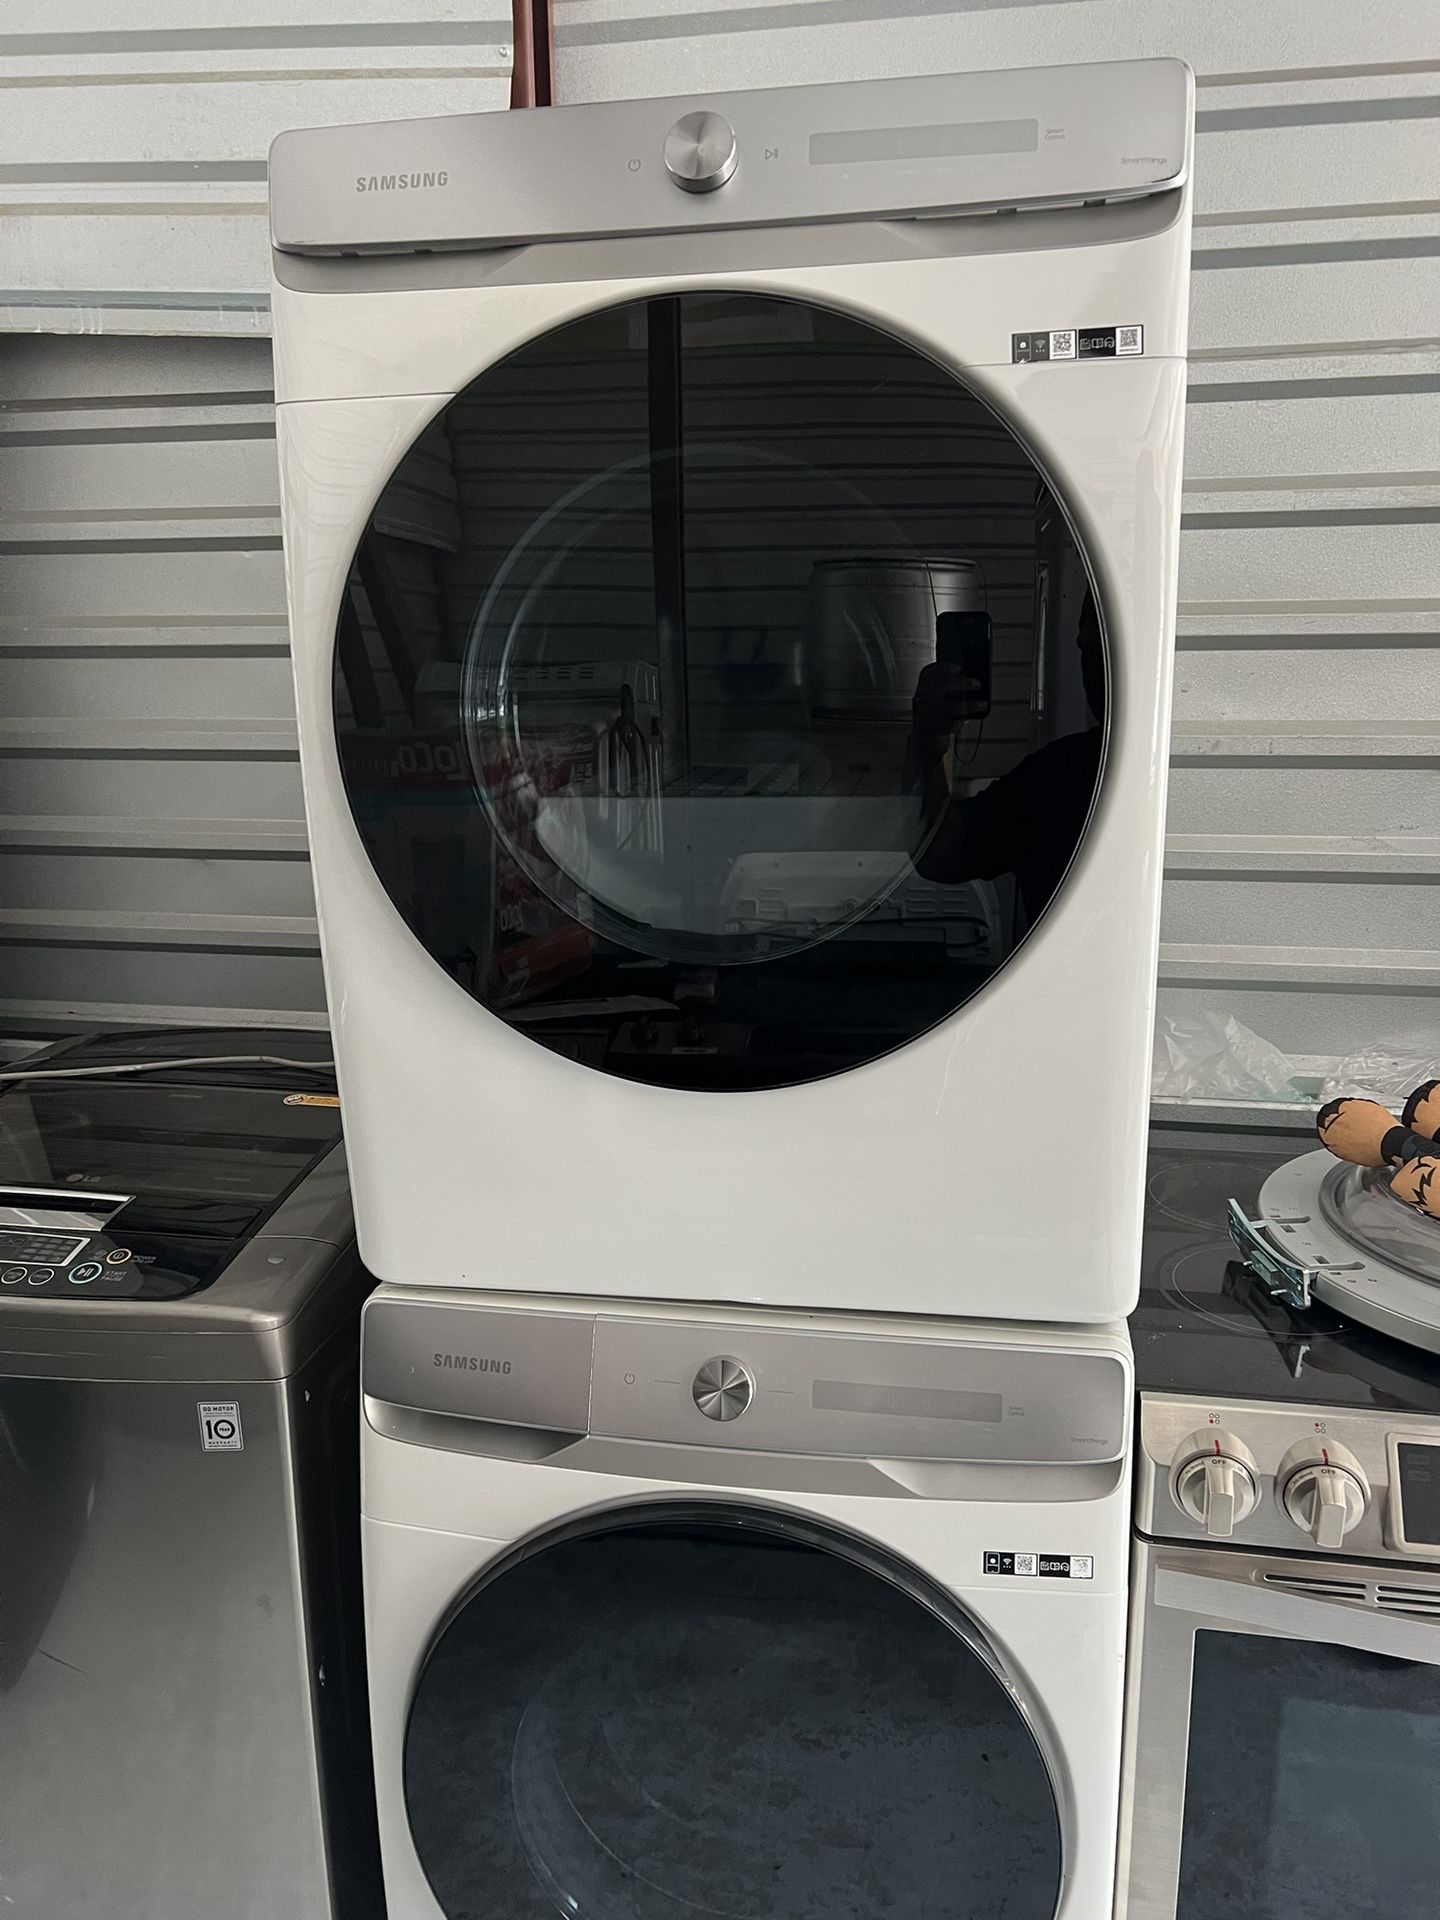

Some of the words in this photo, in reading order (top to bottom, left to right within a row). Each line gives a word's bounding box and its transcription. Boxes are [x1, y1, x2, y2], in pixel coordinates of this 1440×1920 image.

[356, 171, 449, 193] SAMSUNG
[433, 1353, 512, 1375] SAMSUNG
[206, 1419, 235, 1439] 10
